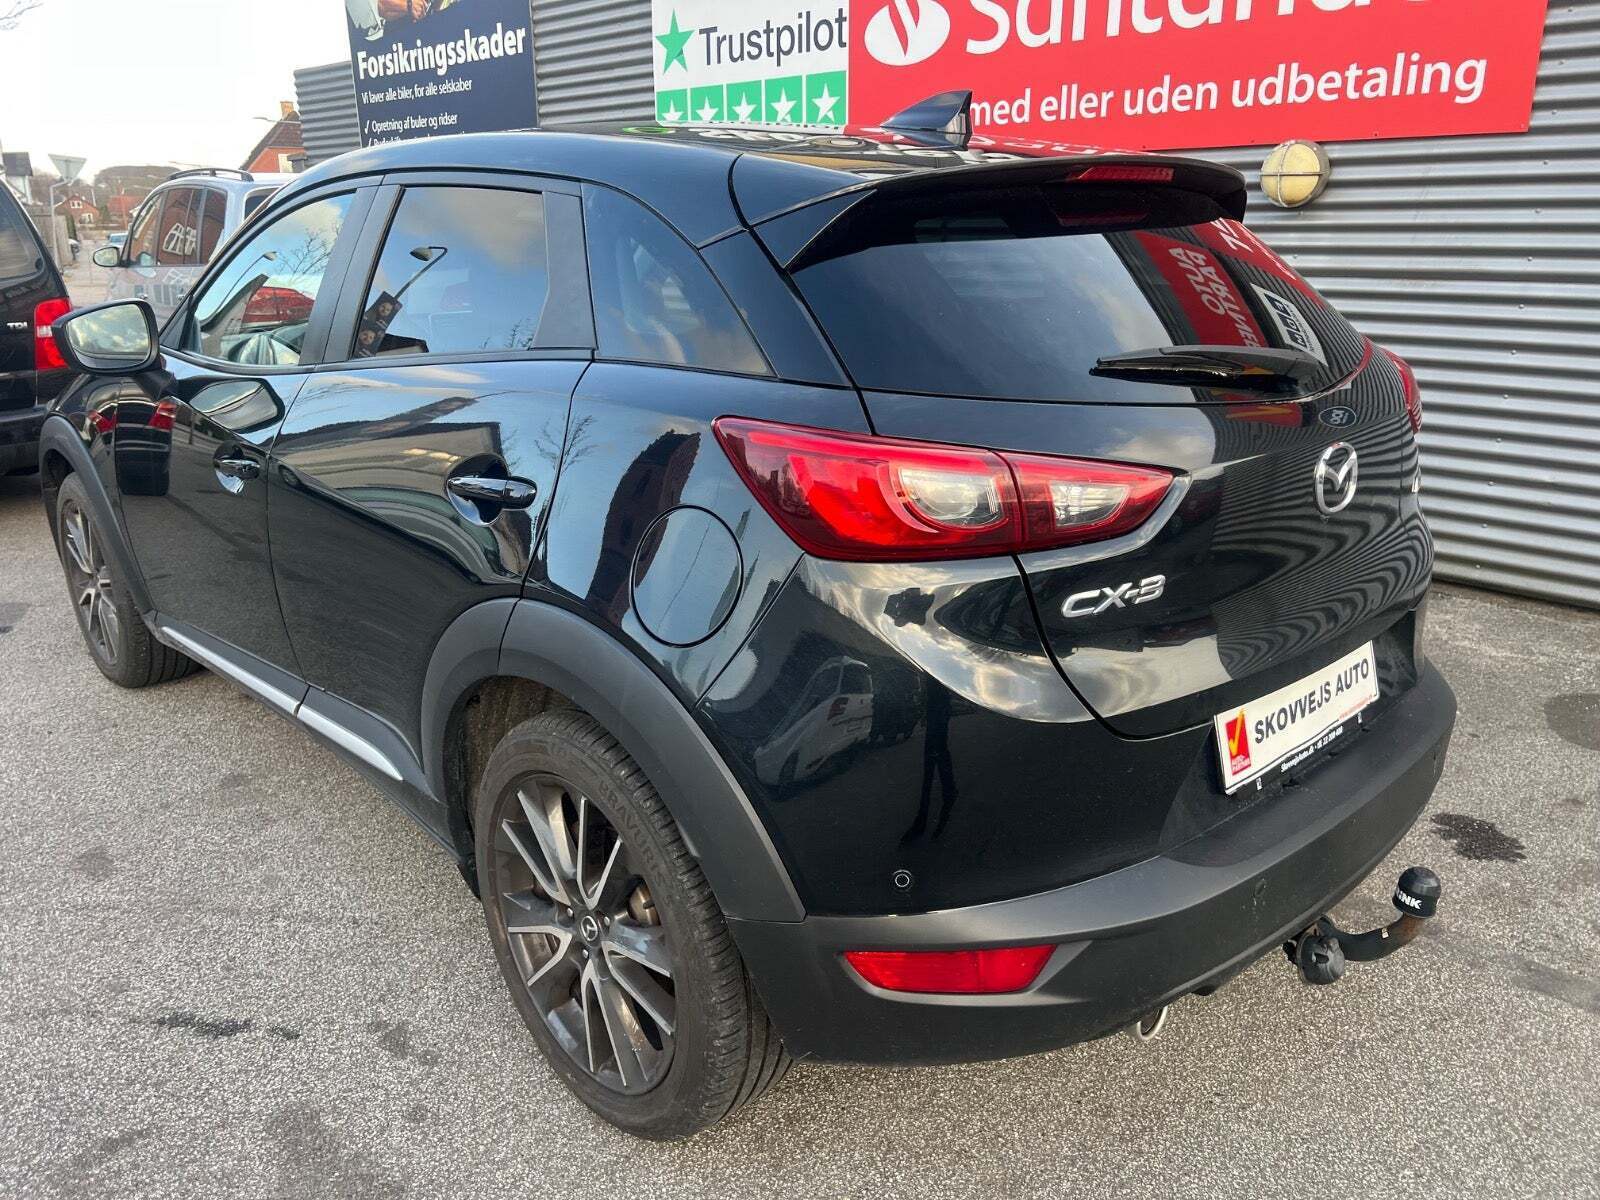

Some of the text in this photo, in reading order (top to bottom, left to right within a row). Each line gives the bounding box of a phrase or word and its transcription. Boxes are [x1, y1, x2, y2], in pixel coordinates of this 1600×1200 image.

[357, 22, 527, 80] Forsikringsskader
[699, 8, 848, 67] Trustpilot
[361, 92, 369, 104] Vi
[369, 90, 384, 104] laver
[385, 88, 397, 102] alle
[414, 84, 425, 98] for
[426, 82, 438, 96] alle
[439, 77, 472, 94] selskaber
[969, 52, 1488, 127] med eller uden udbetaling
[372, 112, 458, 134] Opretning af buler og ridser
[7, 321, 28, 330] TDI
[1062, 574, 1166, 618] CX-3
[1254, 681, 1332, 744] SKOVVEJS
[1335, 658, 1369, 697] AUTO
